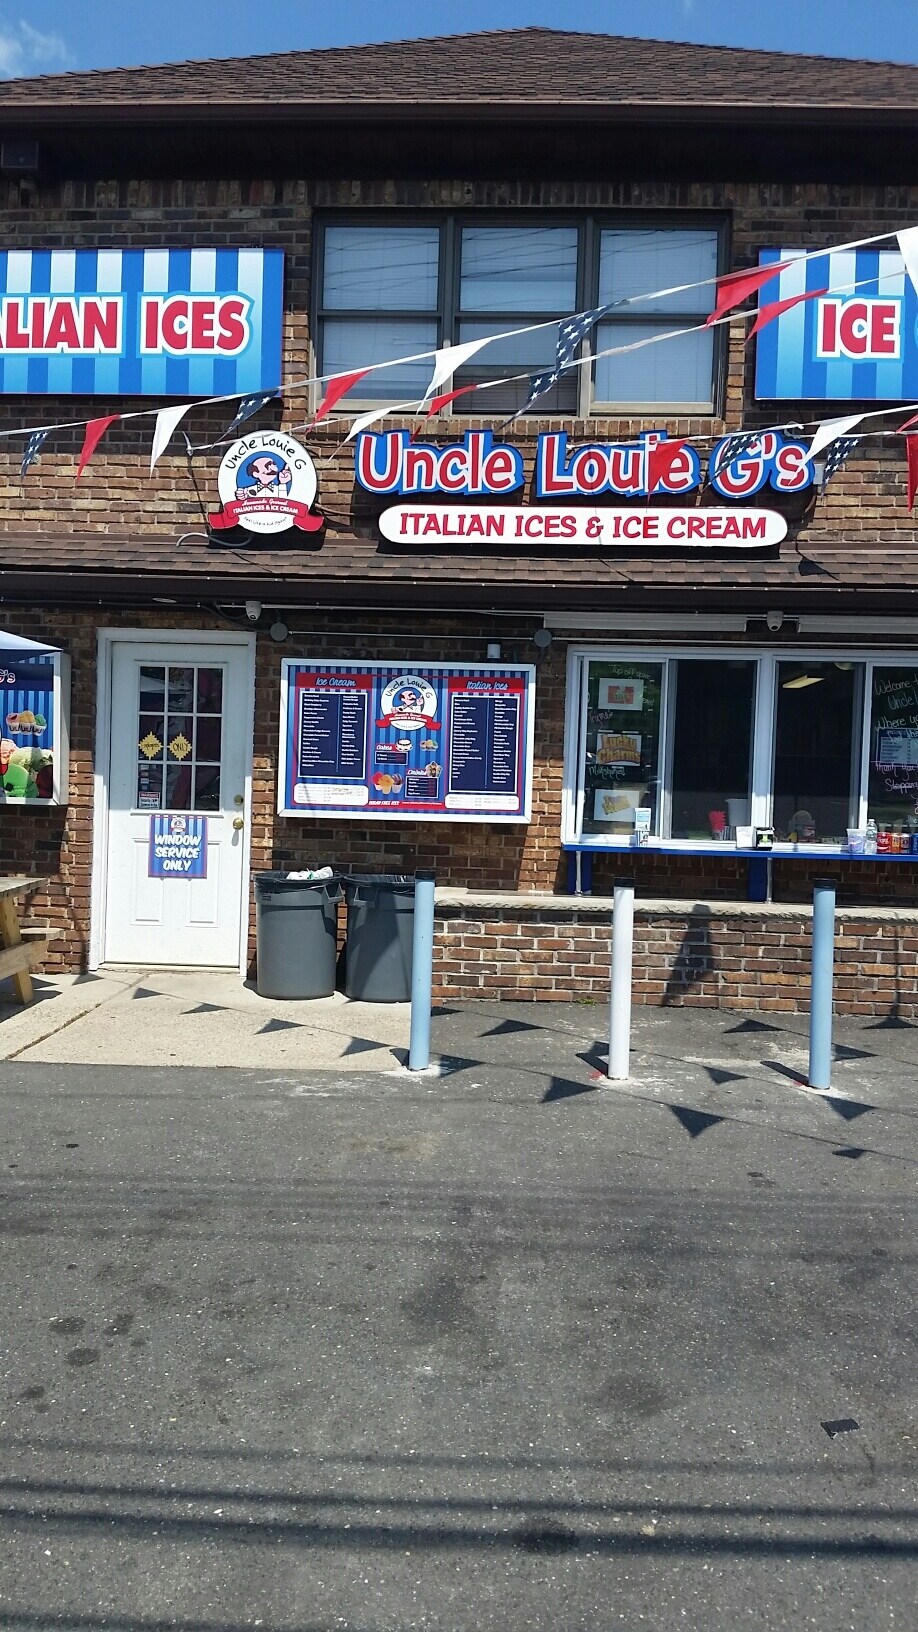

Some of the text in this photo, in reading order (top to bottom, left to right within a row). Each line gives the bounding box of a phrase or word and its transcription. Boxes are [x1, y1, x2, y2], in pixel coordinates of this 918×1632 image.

[0, 297, 248, 351] LIAN ICES
[821, 302, 896, 354] ICE
[225, 436, 307, 470] Uncle Louie G
[360, 431, 517, 491] Uncle
[718, 432, 806, 494] G's
[232, 504, 254, 514] ITALIAN
[280, 505, 299, 514] CREAM
[399, 512, 767, 539] ITALIAN ICES & ICE CREAM
[315, 677, 357, 687] Ice Cream
[385, 677, 434, 699] Uncle Louie G
[466, 680, 509, 691] Italian Ices
[874, 679, 913, 695] Welcome
[887, 691, 914, 710] Uncle
[601, 733, 638, 751] Lucky
[597, 747, 641, 765] Charms
[154, 834, 202, 847] WINDOW
[154, 846, 201, 859] SERVICE
[162, 859, 192, 872] ONLY
